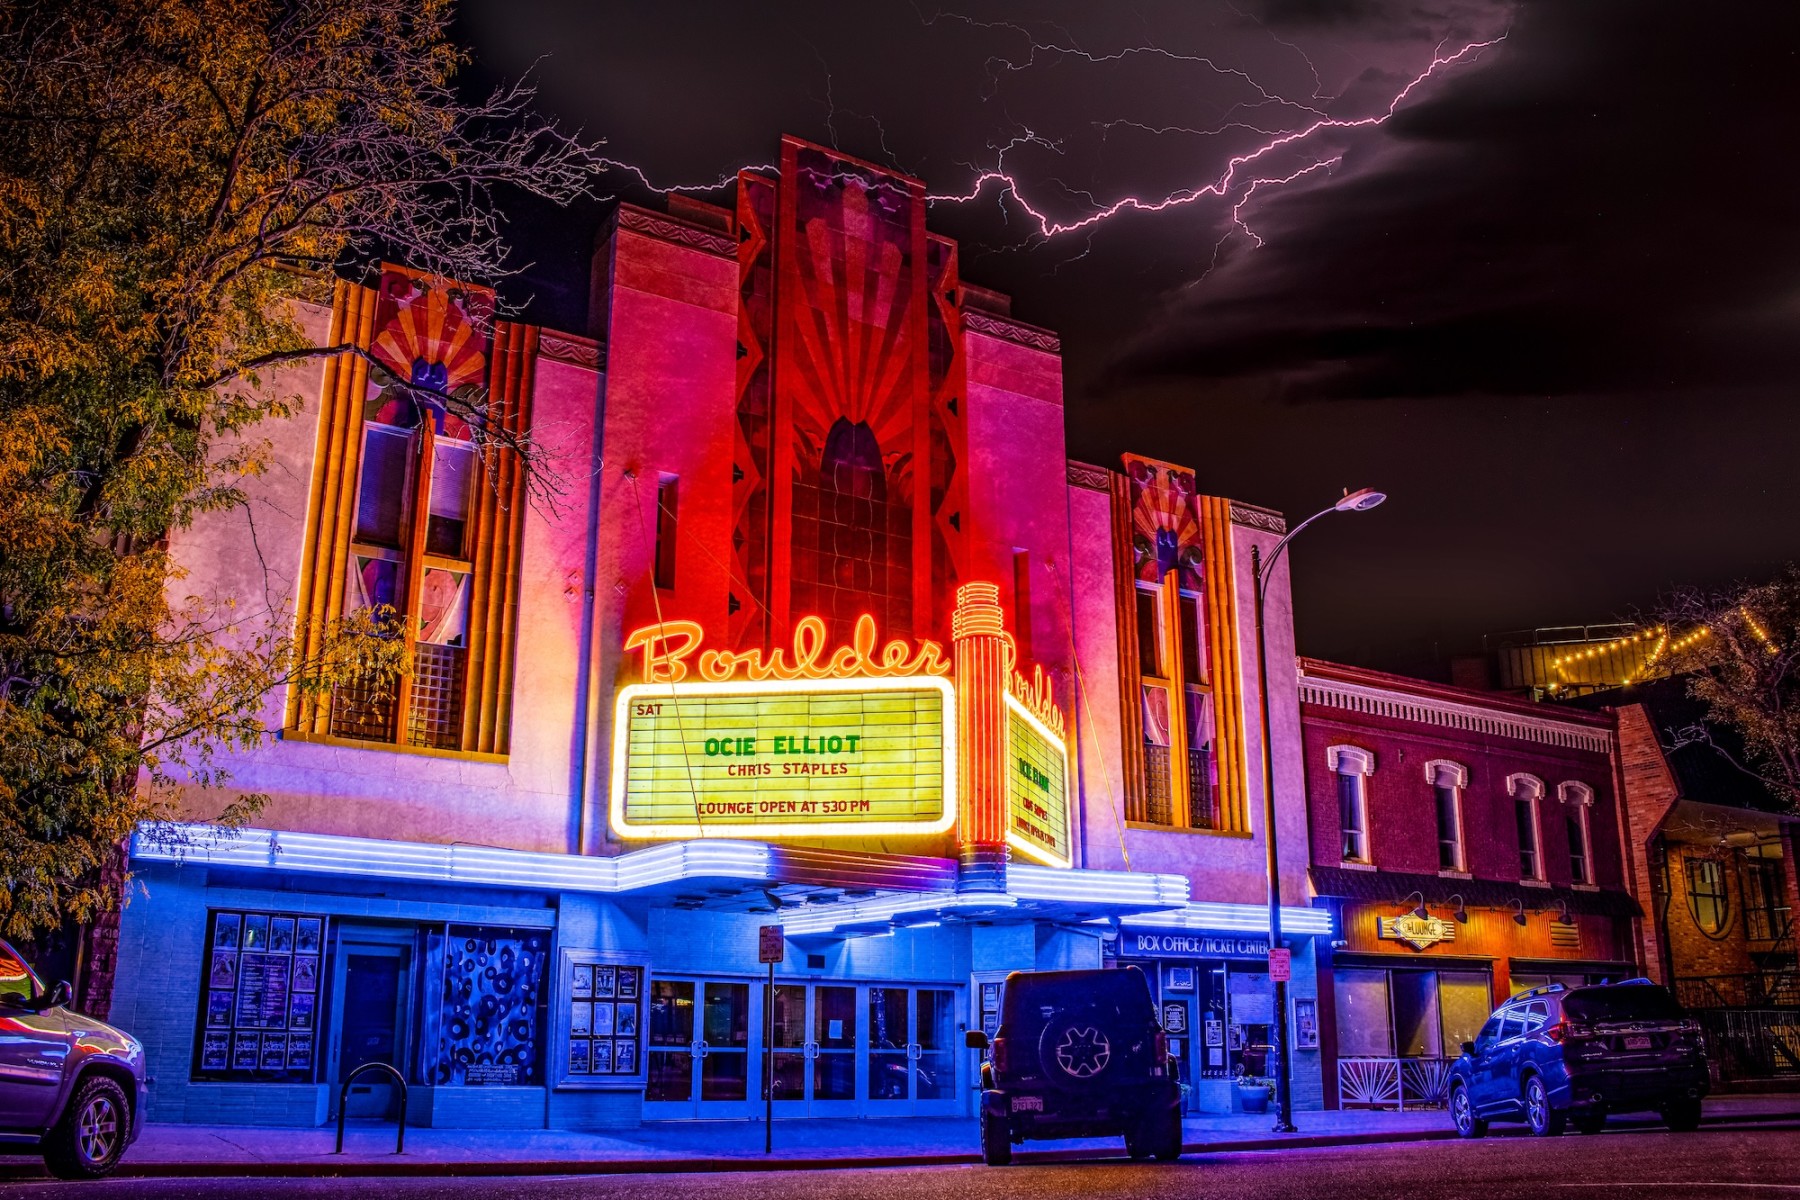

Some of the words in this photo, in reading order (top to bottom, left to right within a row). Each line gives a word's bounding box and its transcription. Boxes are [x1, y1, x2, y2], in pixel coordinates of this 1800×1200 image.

[624, 613, 951, 684] Boulder
[636, 704, 663, 715] SAT
[705, 737, 755, 757] OCIE
[774, 735, 860, 755] ELLIOT
[728, 763, 771, 776] CHRIS
[783, 762, 848, 775] STAPLES
[698, 803, 754, 814] LOUNGE
[760, 801, 796, 812] OPEN
[801, 801, 818, 813] AT
[822, 801, 847, 813] 530
[850, 800, 870, 812] PM
[1411, 922, 1436, 935] LOUNGE
[1138, 935, 1160, 950] BOX
[1237, 940, 1269, 955] CENTER
